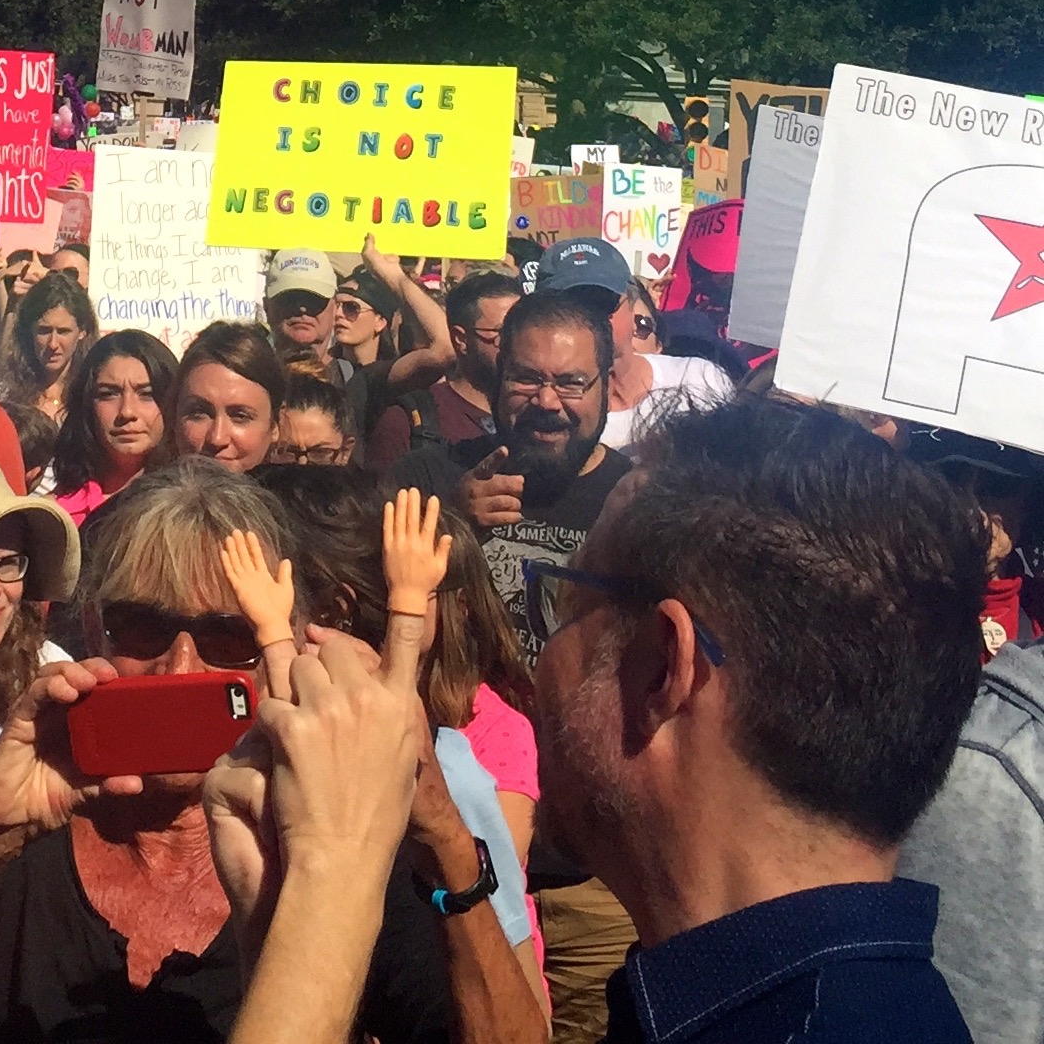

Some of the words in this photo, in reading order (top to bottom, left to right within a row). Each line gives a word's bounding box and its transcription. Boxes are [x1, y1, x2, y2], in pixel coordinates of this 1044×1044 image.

[14, 53, 54, 100] just
[273, 78, 456, 110] CHOICE
[3, 102, 41, 124] have
[856, 77, 917, 120] The
[929, 91, 1009, 137] New
[275, 127, 321, 152] IS
[358, 131, 443, 160] NOT
[774, 110, 820, 146] The
[107, 152, 136, 184] I
[144, 159, 182, 188] am
[586, 147, 606, 162] MY
[612, 168, 646, 196] BE
[653, 176, 675, 194] the
[119, 191, 175, 240] longer
[225, 188, 487, 230] NEGOTIABLE
[603, 204, 681, 248] CHANGE
[689, 210, 727, 239] THIS
[96, 233, 125, 261] the
[125, 233, 169, 268] things
[171, 234, 187, 257] I
[103, 265, 178, 300] change,
[183, 259, 202, 286] I
[211, 264, 243, 284] am
[98, 292, 180, 334] changing
[178, 289, 215, 323] the
[215, 288, 257, 319] things
[516, 627, 546, 654] EAT
